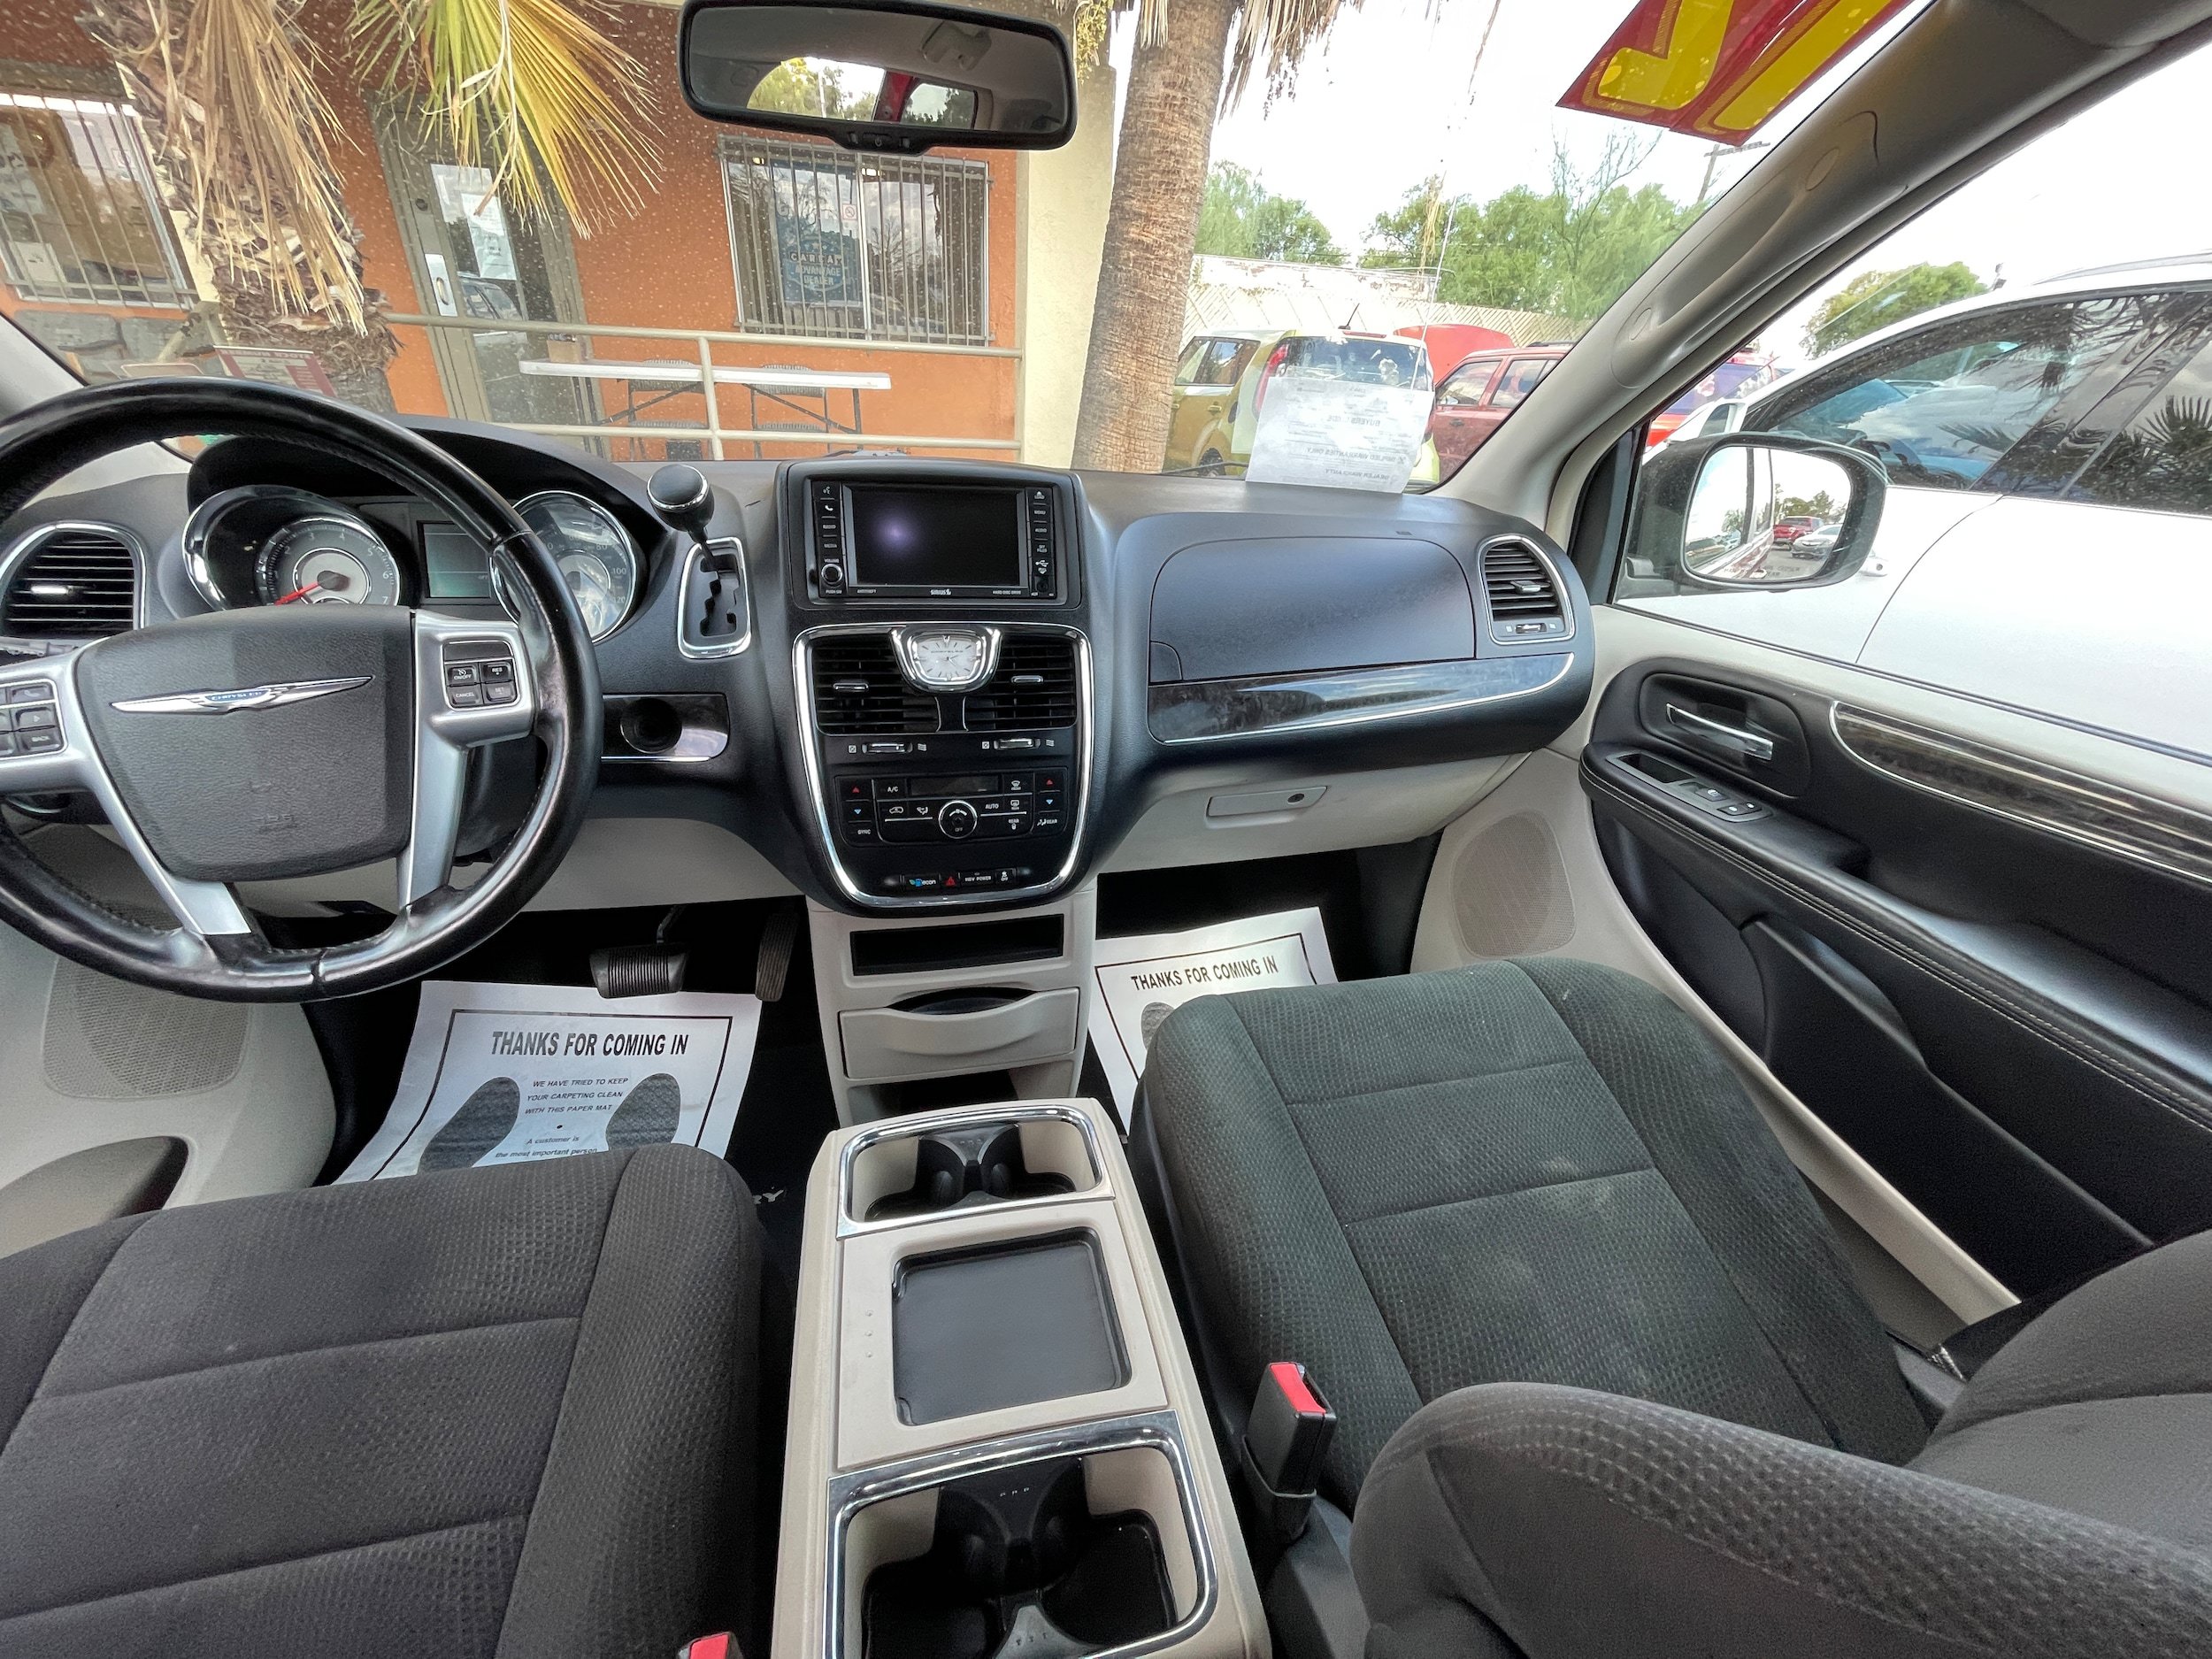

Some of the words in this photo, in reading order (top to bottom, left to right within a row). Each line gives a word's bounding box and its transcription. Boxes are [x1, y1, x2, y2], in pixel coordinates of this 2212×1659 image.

[339, 532, 345, 541] 4
[382, 571, 389, 580] 6
[1131, 970, 1183, 991] THANKS
[1185, 966, 1211, 984] FOR
[1212, 959, 1261, 980] COMING
[1263, 956, 1279, 973] IN
[491, 1031, 559, 1056] THANKS
[564, 1033, 597, 1056] FOR
[603, 1033, 666, 1056] COMING
[671, 1034, 689, 1056] IN
[532, 1148, 569, 1157] important
